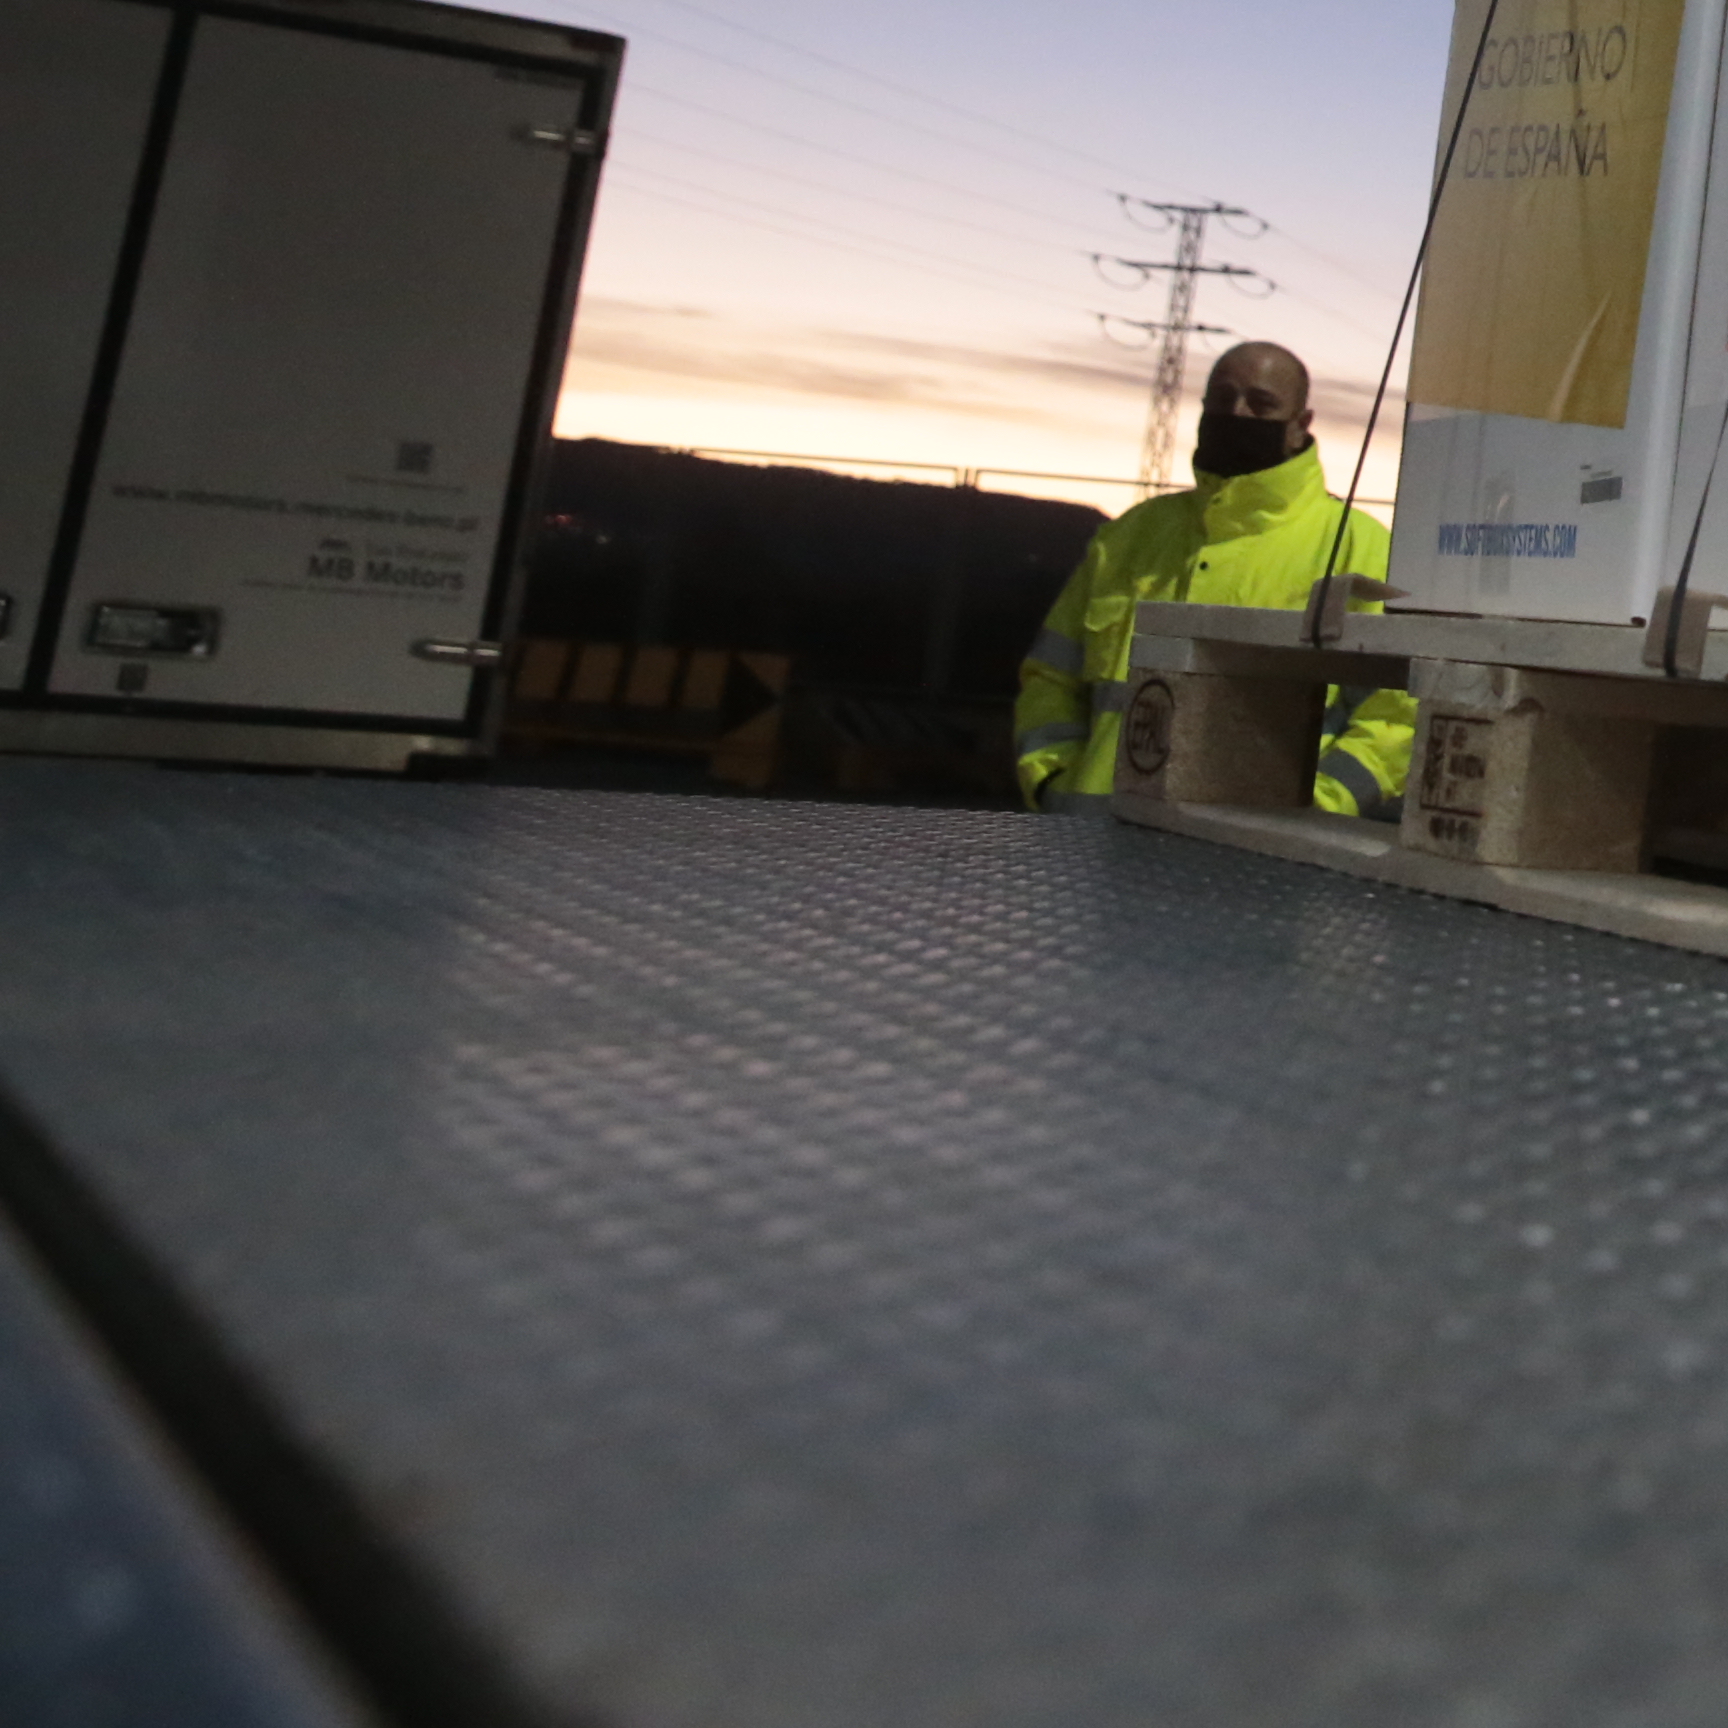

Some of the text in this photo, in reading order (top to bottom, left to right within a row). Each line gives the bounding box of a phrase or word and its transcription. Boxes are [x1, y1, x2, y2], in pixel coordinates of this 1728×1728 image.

[1477, 25, 1627, 90] GOBIERNO
[1464, 108, 1610, 179] DE ESPAÑA
[365, 560, 466, 592] Motors
